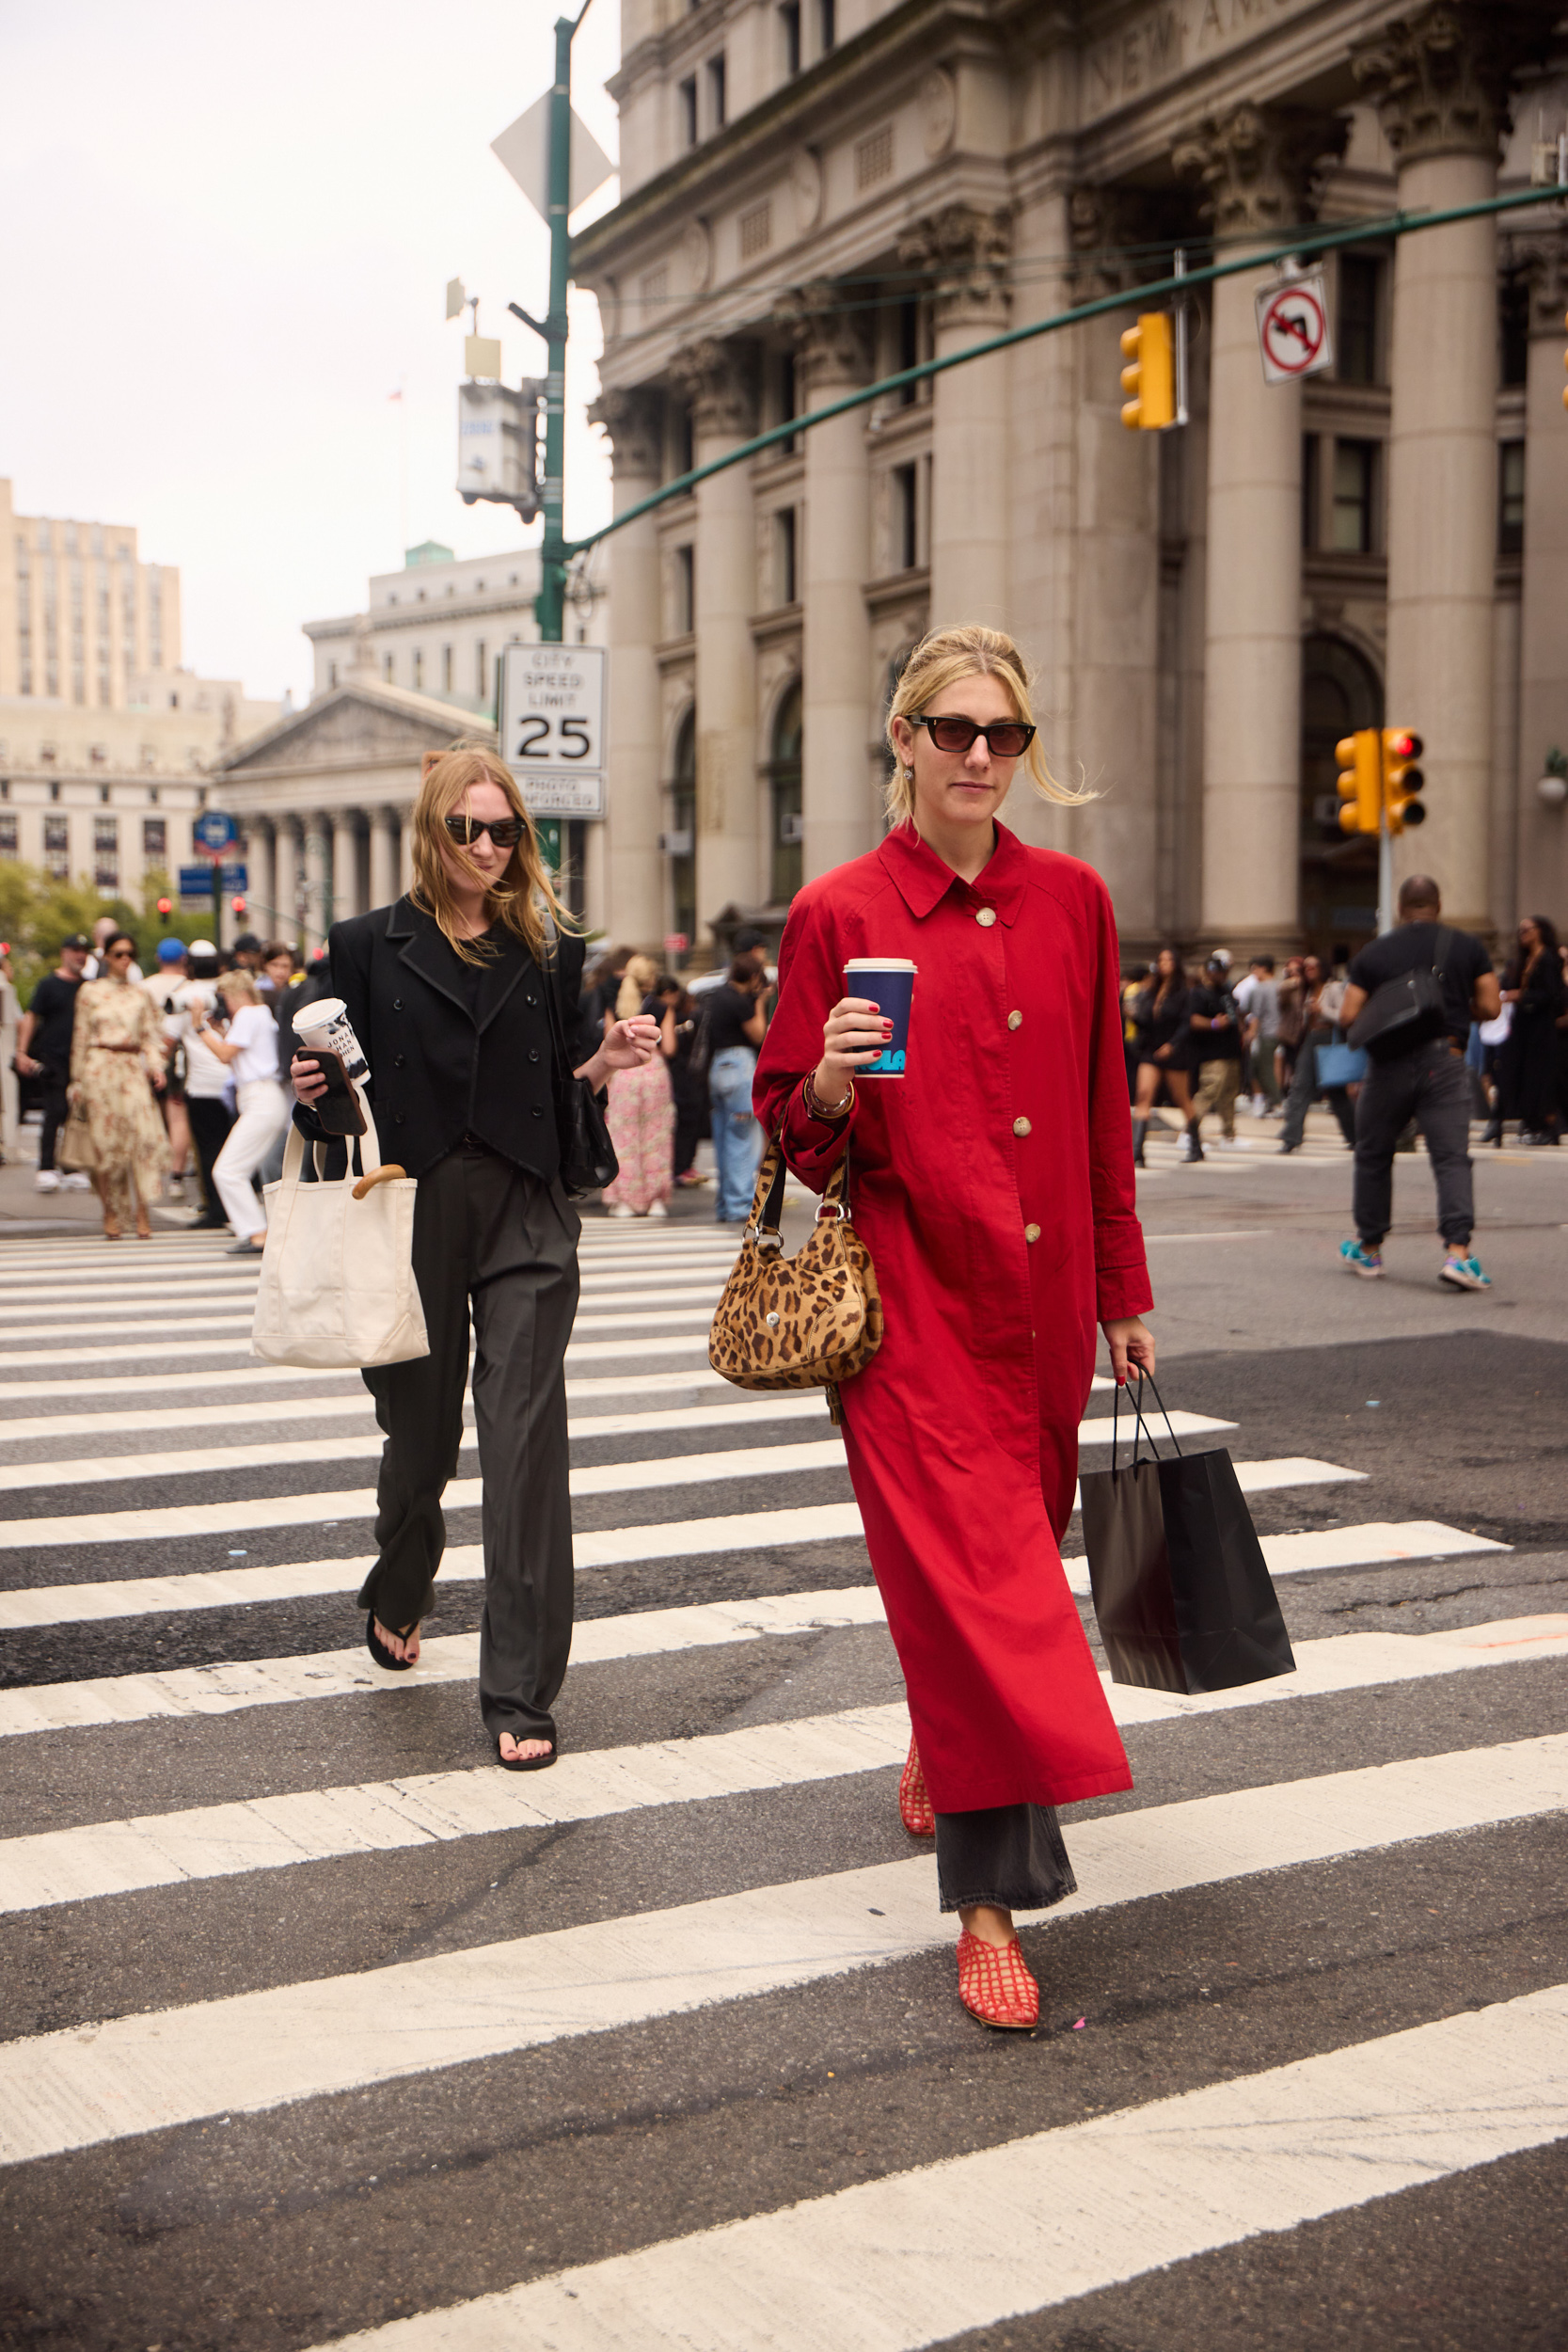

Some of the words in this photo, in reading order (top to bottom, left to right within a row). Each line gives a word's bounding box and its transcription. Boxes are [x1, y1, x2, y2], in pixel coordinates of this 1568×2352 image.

[1085, 9, 1178, 94] NEW
[532, 652, 574, 667] CITY
[524, 672, 584, 688] SPEED
[529, 692, 577, 708] LIMIT
[518, 714, 591, 759] 25
[525, 777, 579, 792] PHOTO
[336, 1039, 352, 1052] HAN
